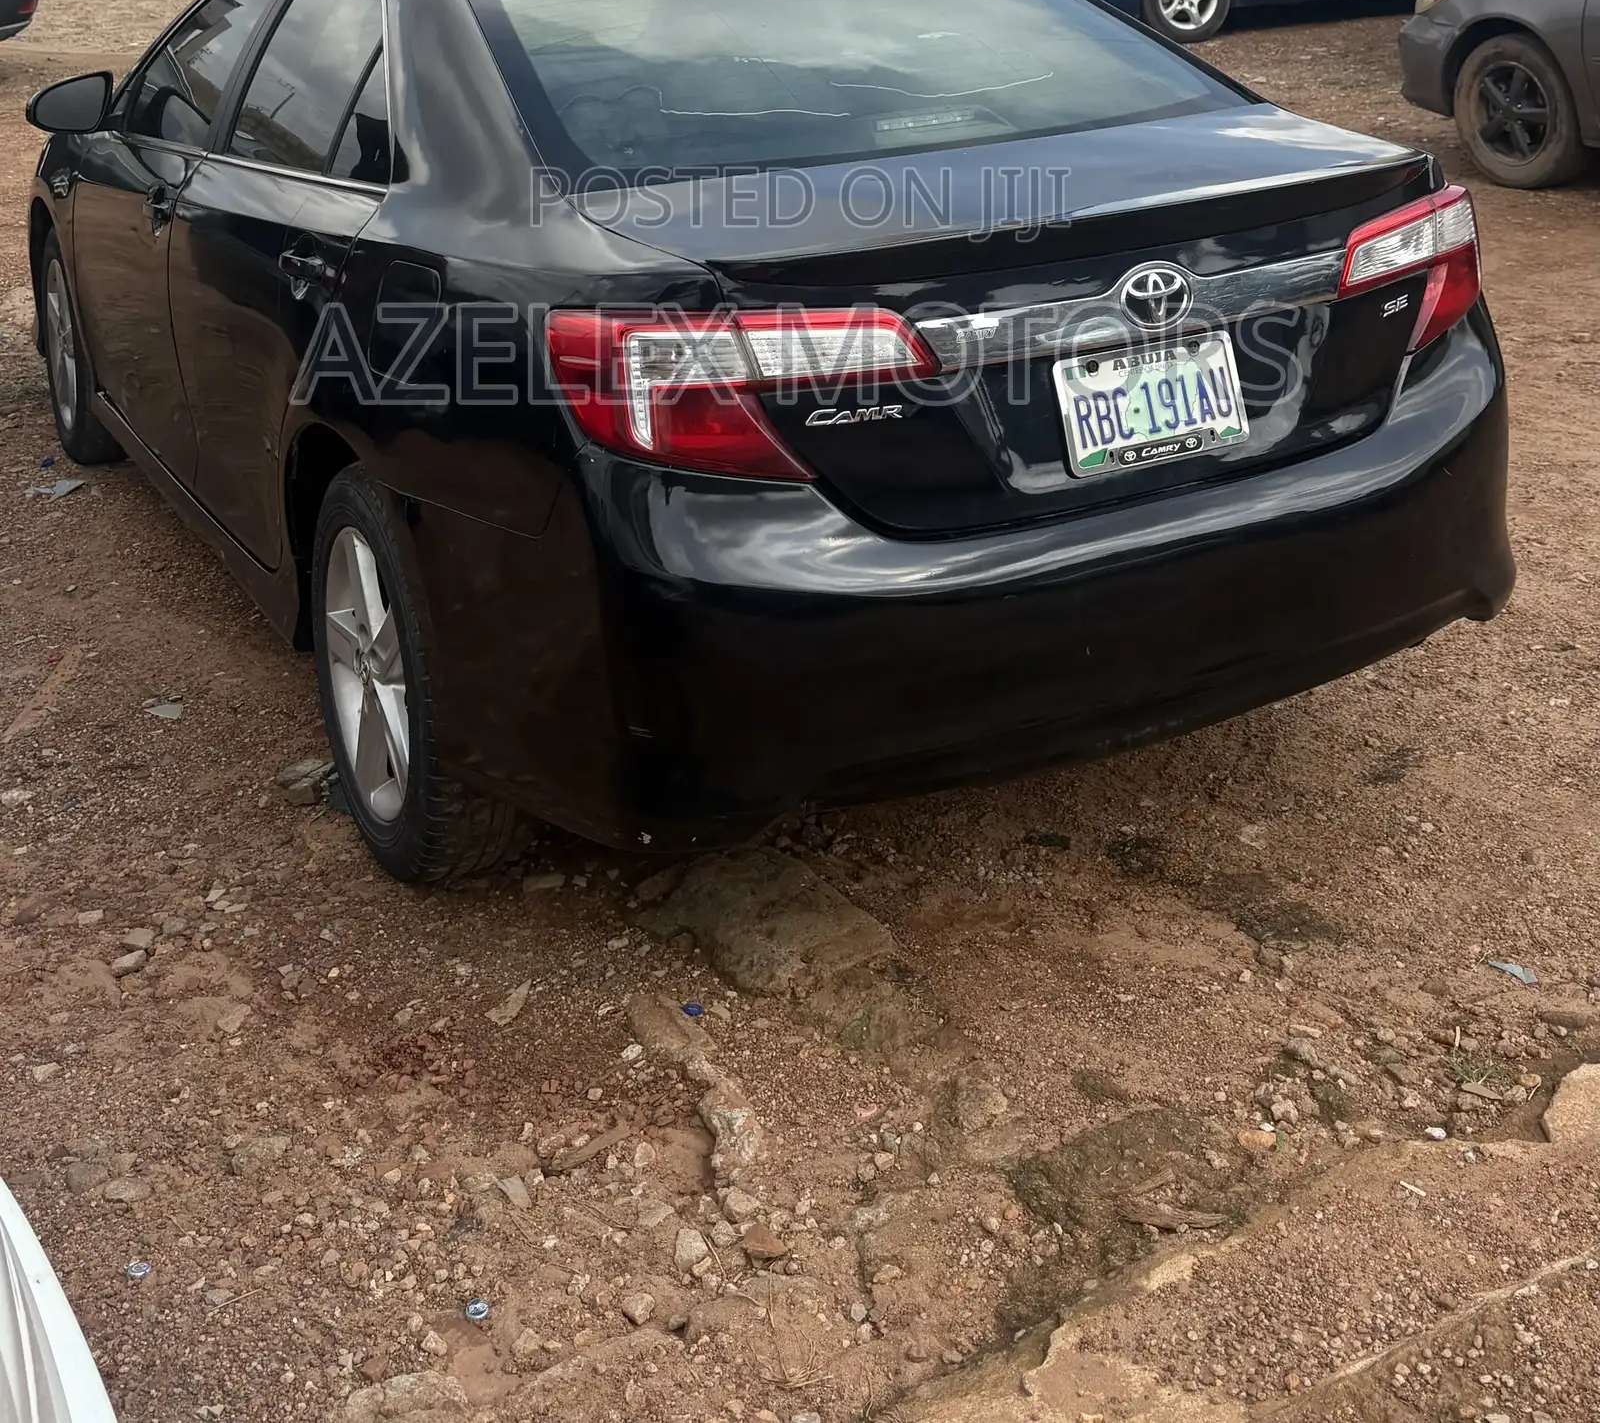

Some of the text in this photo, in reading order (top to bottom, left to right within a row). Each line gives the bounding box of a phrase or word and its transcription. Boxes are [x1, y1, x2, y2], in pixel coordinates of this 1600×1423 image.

[1381, 294, 1409, 318] SE
[1112, 349, 1178, 371] ABUJA
[1141, 442, 1181, 457] CAMRY
